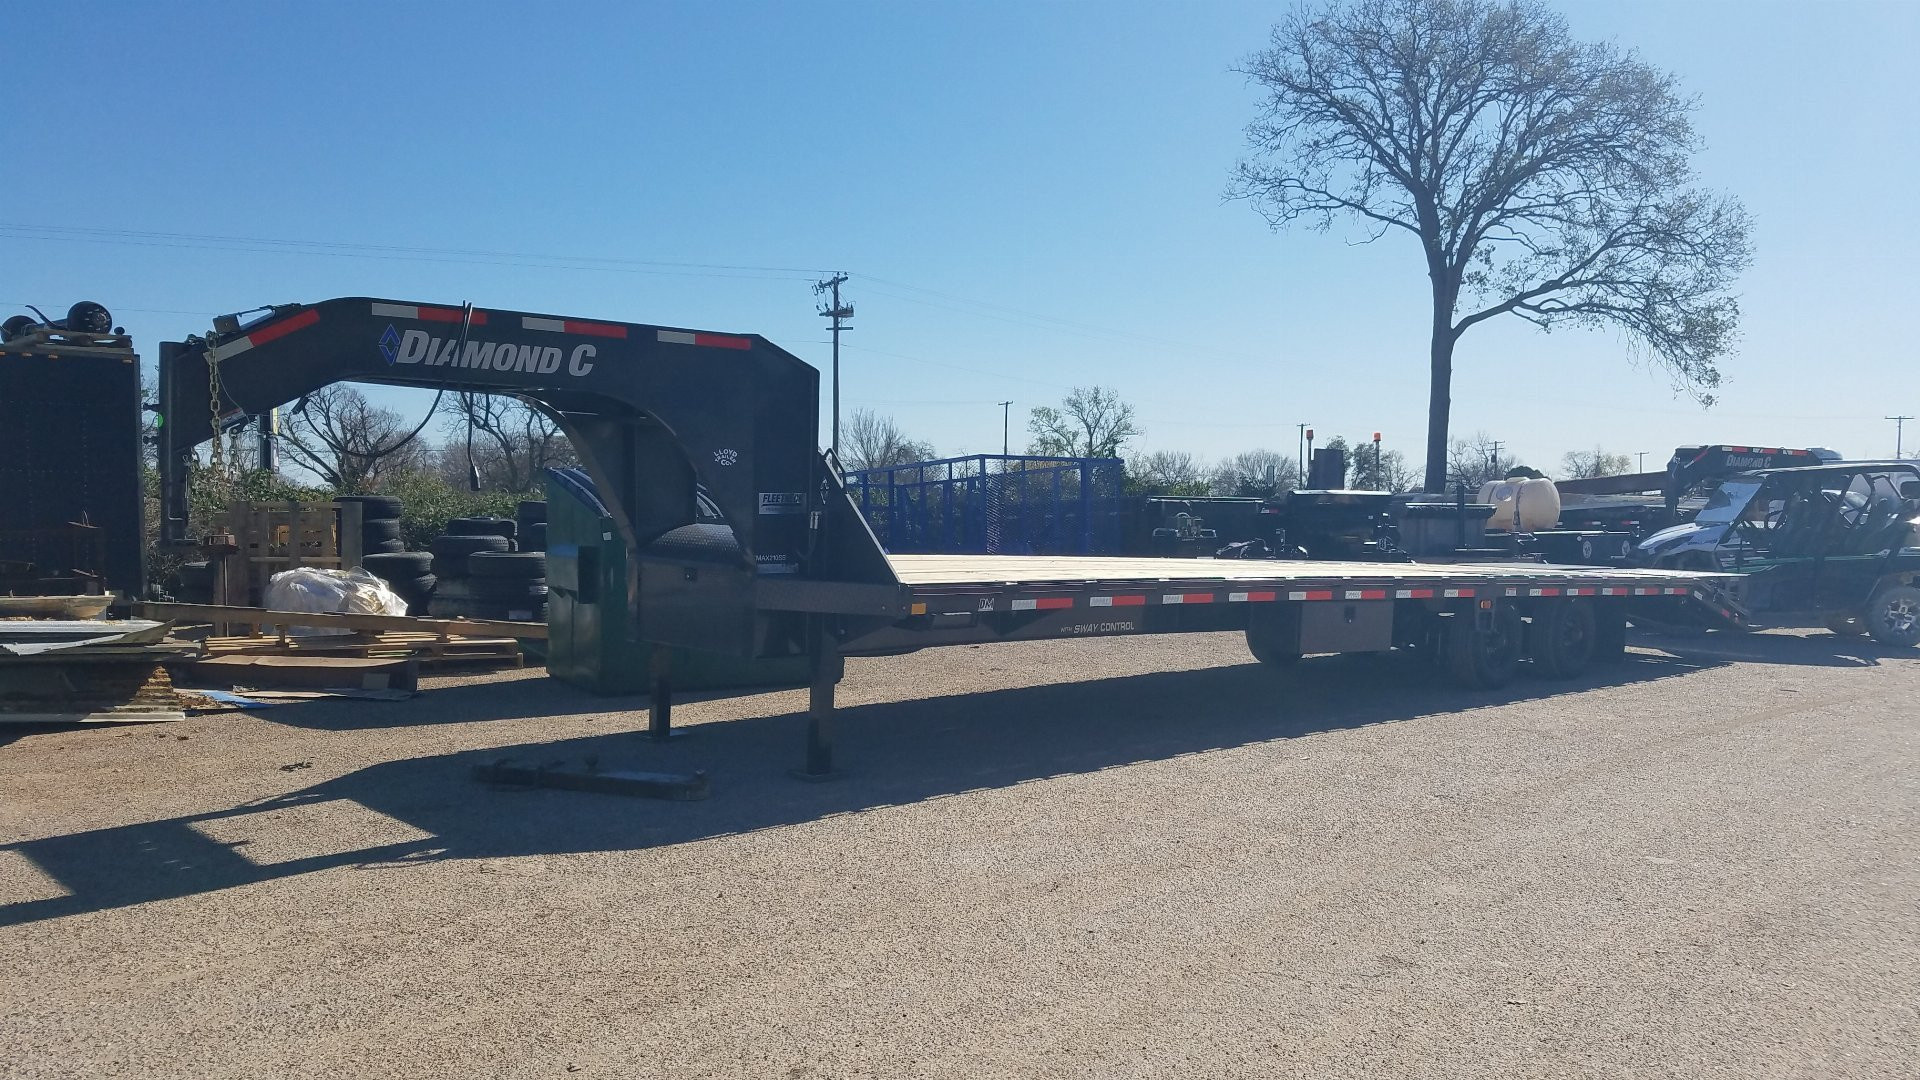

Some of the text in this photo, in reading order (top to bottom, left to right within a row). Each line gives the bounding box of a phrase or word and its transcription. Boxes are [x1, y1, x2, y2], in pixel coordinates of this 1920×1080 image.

[396, 329, 597, 377] DIAMOND C
[713, 448, 738, 458] LLOYD
[714, 454, 737, 464] TRAILER
[1726, 454, 1772, 469] DIAMOND C
[1073, 623, 1099, 634] SWAY
[1100, 621, 1135, 632] CONTROL
